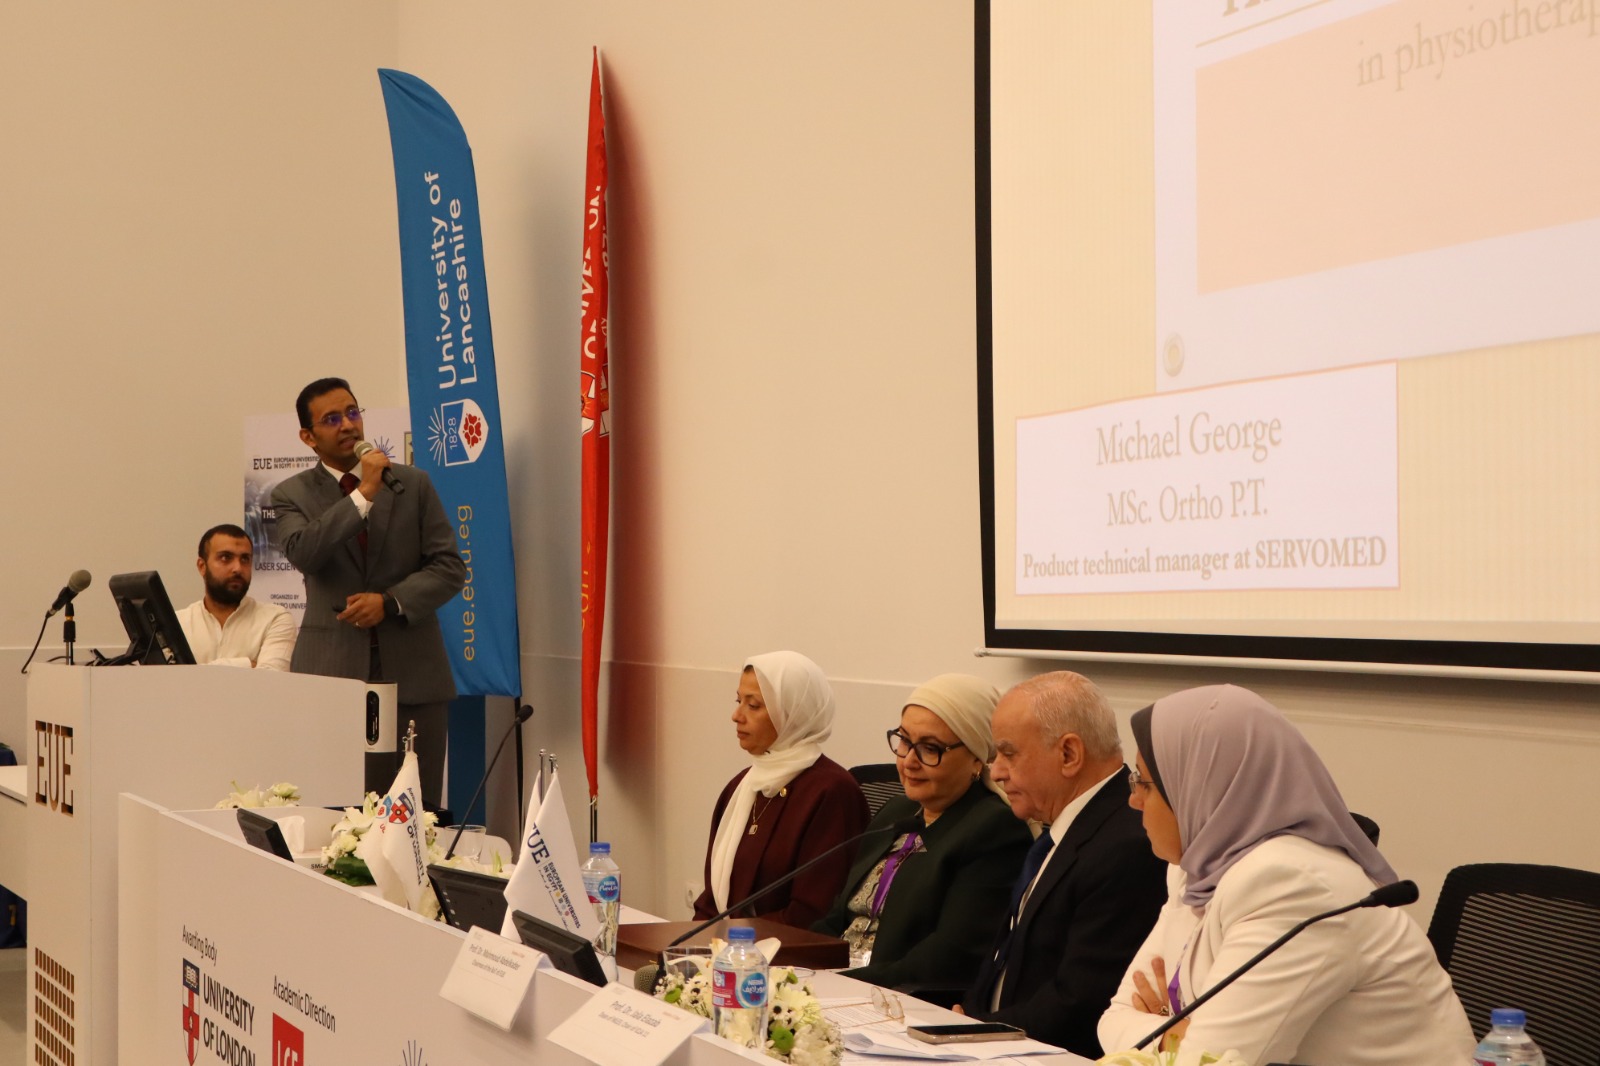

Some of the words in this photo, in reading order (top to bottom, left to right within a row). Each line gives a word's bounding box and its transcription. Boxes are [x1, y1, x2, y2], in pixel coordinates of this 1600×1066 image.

[1356, 40, 1386, 87] in
[424, 171, 441, 205] of
[431, 216, 457, 389] University
[449, 198, 478, 385] Lancashire
[448, 417, 458, 450] 1828
[1096, 414, 1182, 466] Michael
[1189, 411, 1282, 463] George
[253, 457, 272, 471] EUE
[1107, 489, 1152, 527] MSc.
[1159, 483, 1223, 523] Ortho
[1230, 478, 1268, 518] P.T.
[254, 562, 275, 571] LASER
[276, 562, 296, 571] SCIEN
[1023, 552, 1079, 578] Product
[1083, 547, 1151, 576] technical
[1156, 549, 1229, 580] manager
[1234, 547, 1252, 570] at
[1255, 535, 1387, 569] SERVOMED
[35, 720, 74, 818] EUE
[182, 924, 204, 959] Awarding
[205, 937, 217, 967] Body
[203, 972, 255, 1036] UNIVERSITY
[273, 974, 304, 1014] Academic
[305, 993, 336, 1033] Direction
[203, 1017, 214, 1051] OF
